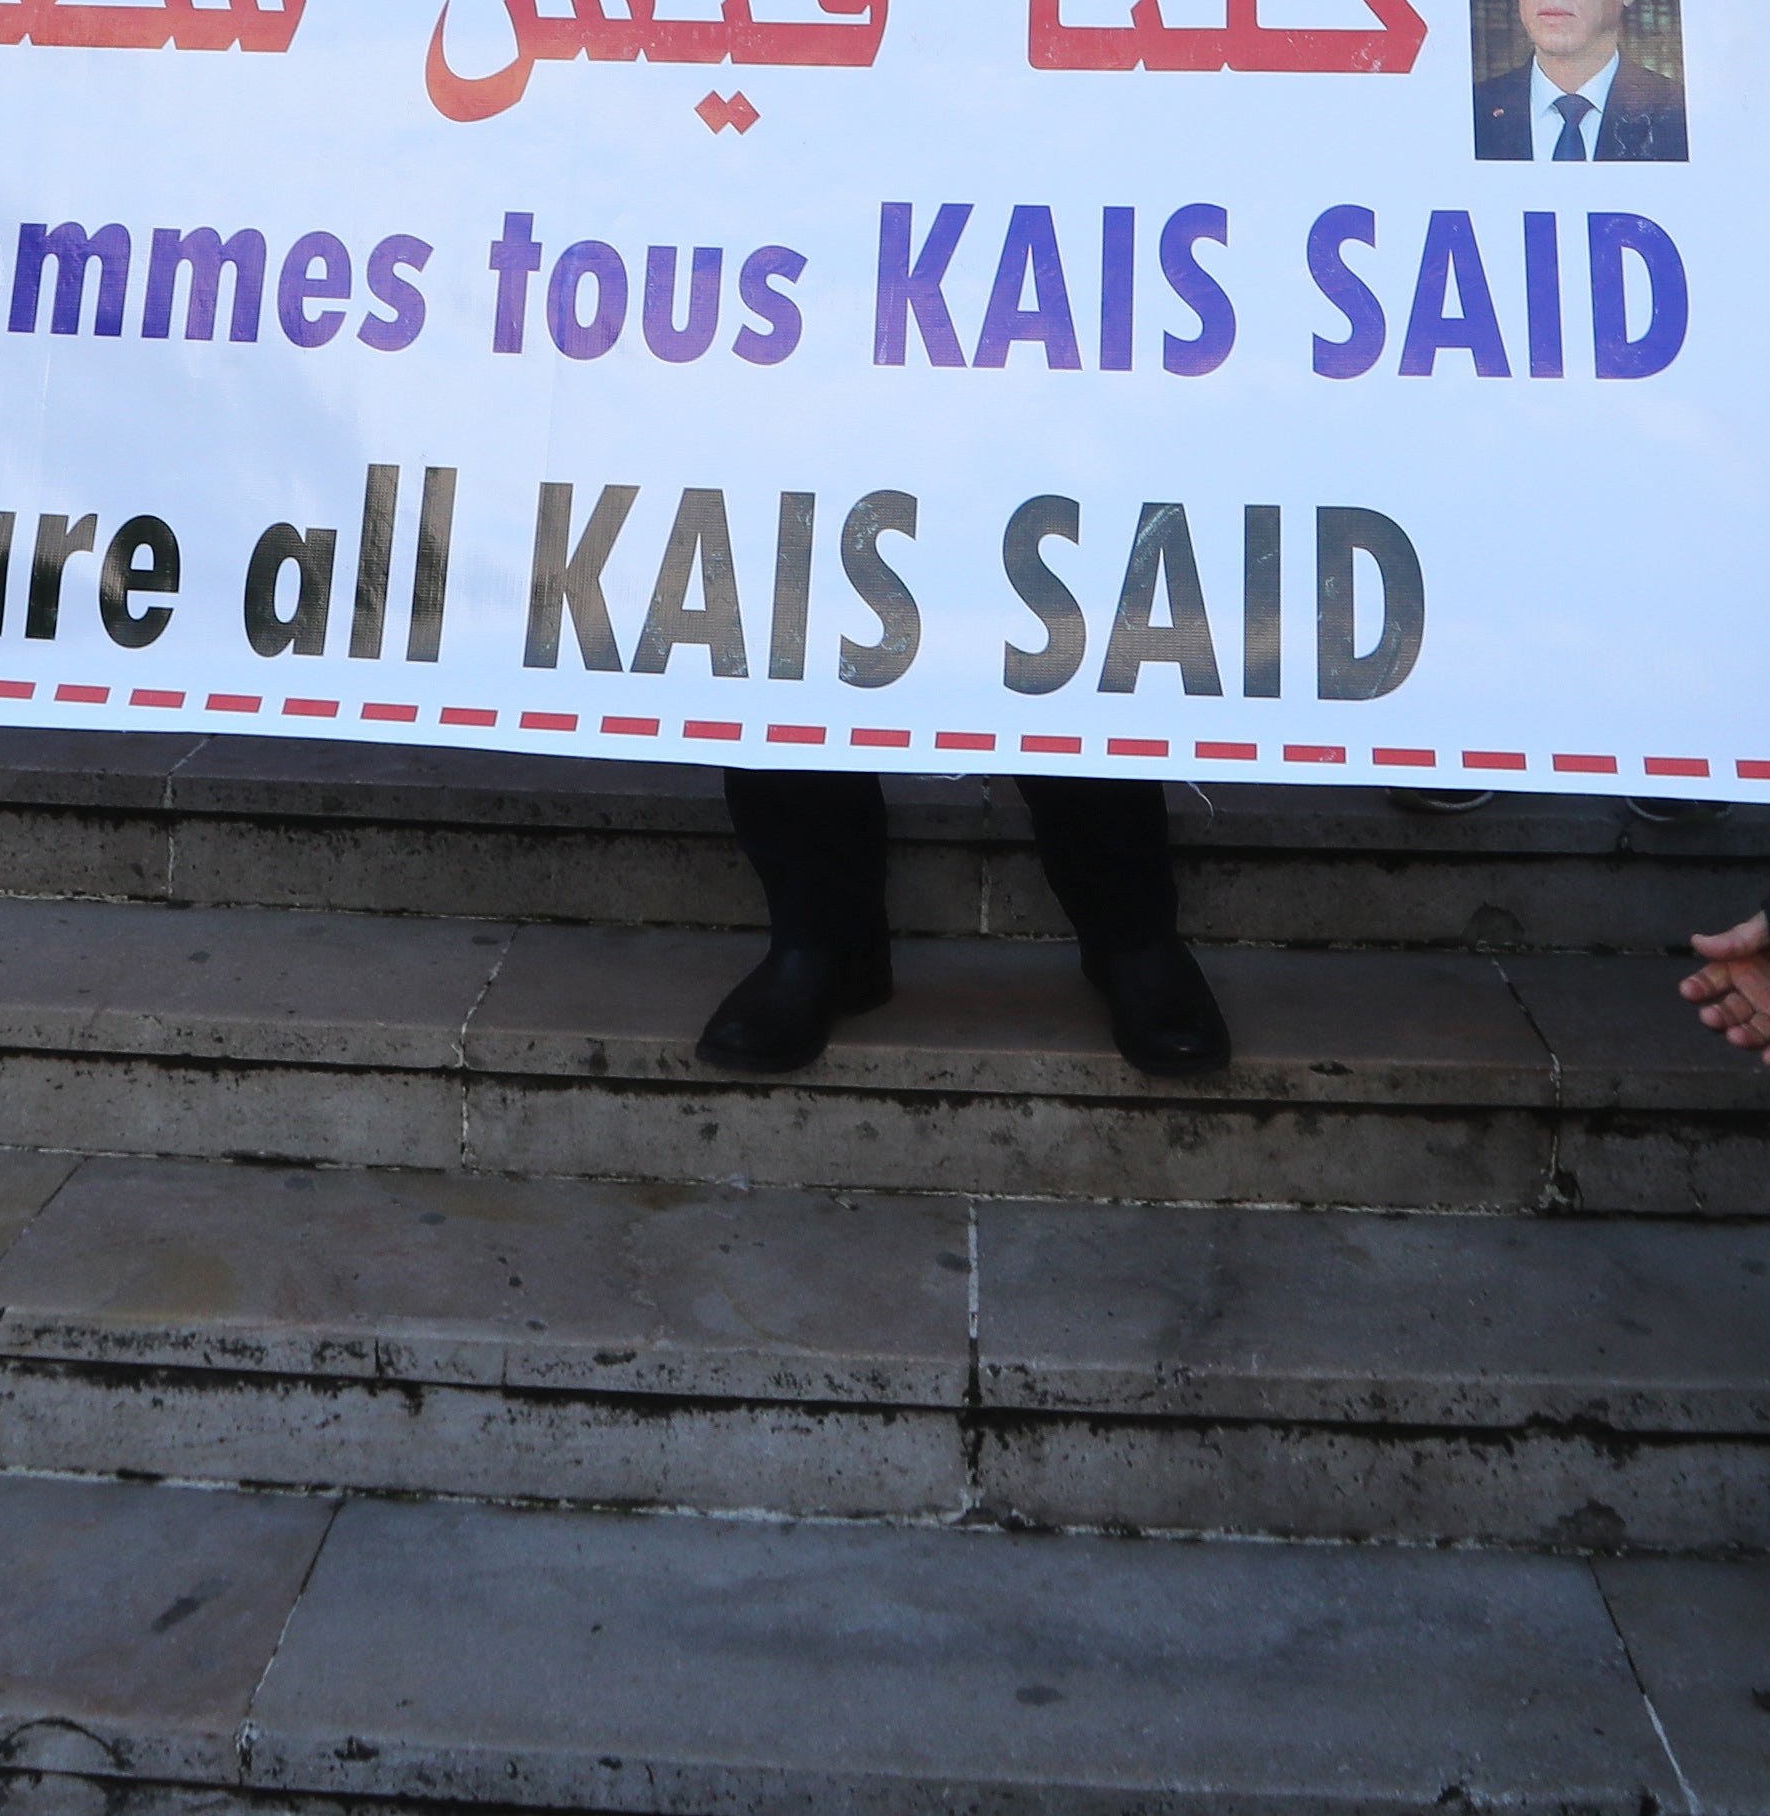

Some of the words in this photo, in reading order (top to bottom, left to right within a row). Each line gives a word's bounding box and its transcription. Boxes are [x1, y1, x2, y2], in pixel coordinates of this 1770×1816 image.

[491, 212, 807, 362] tous
[875, 202, 1236, 376] KAIS
[1307, 204, 1688, 379] SAID
[244, 464, 457, 662] all
[524, 482, 920, 688] KAIS
[1003, 495, 1424, 701] SAID
